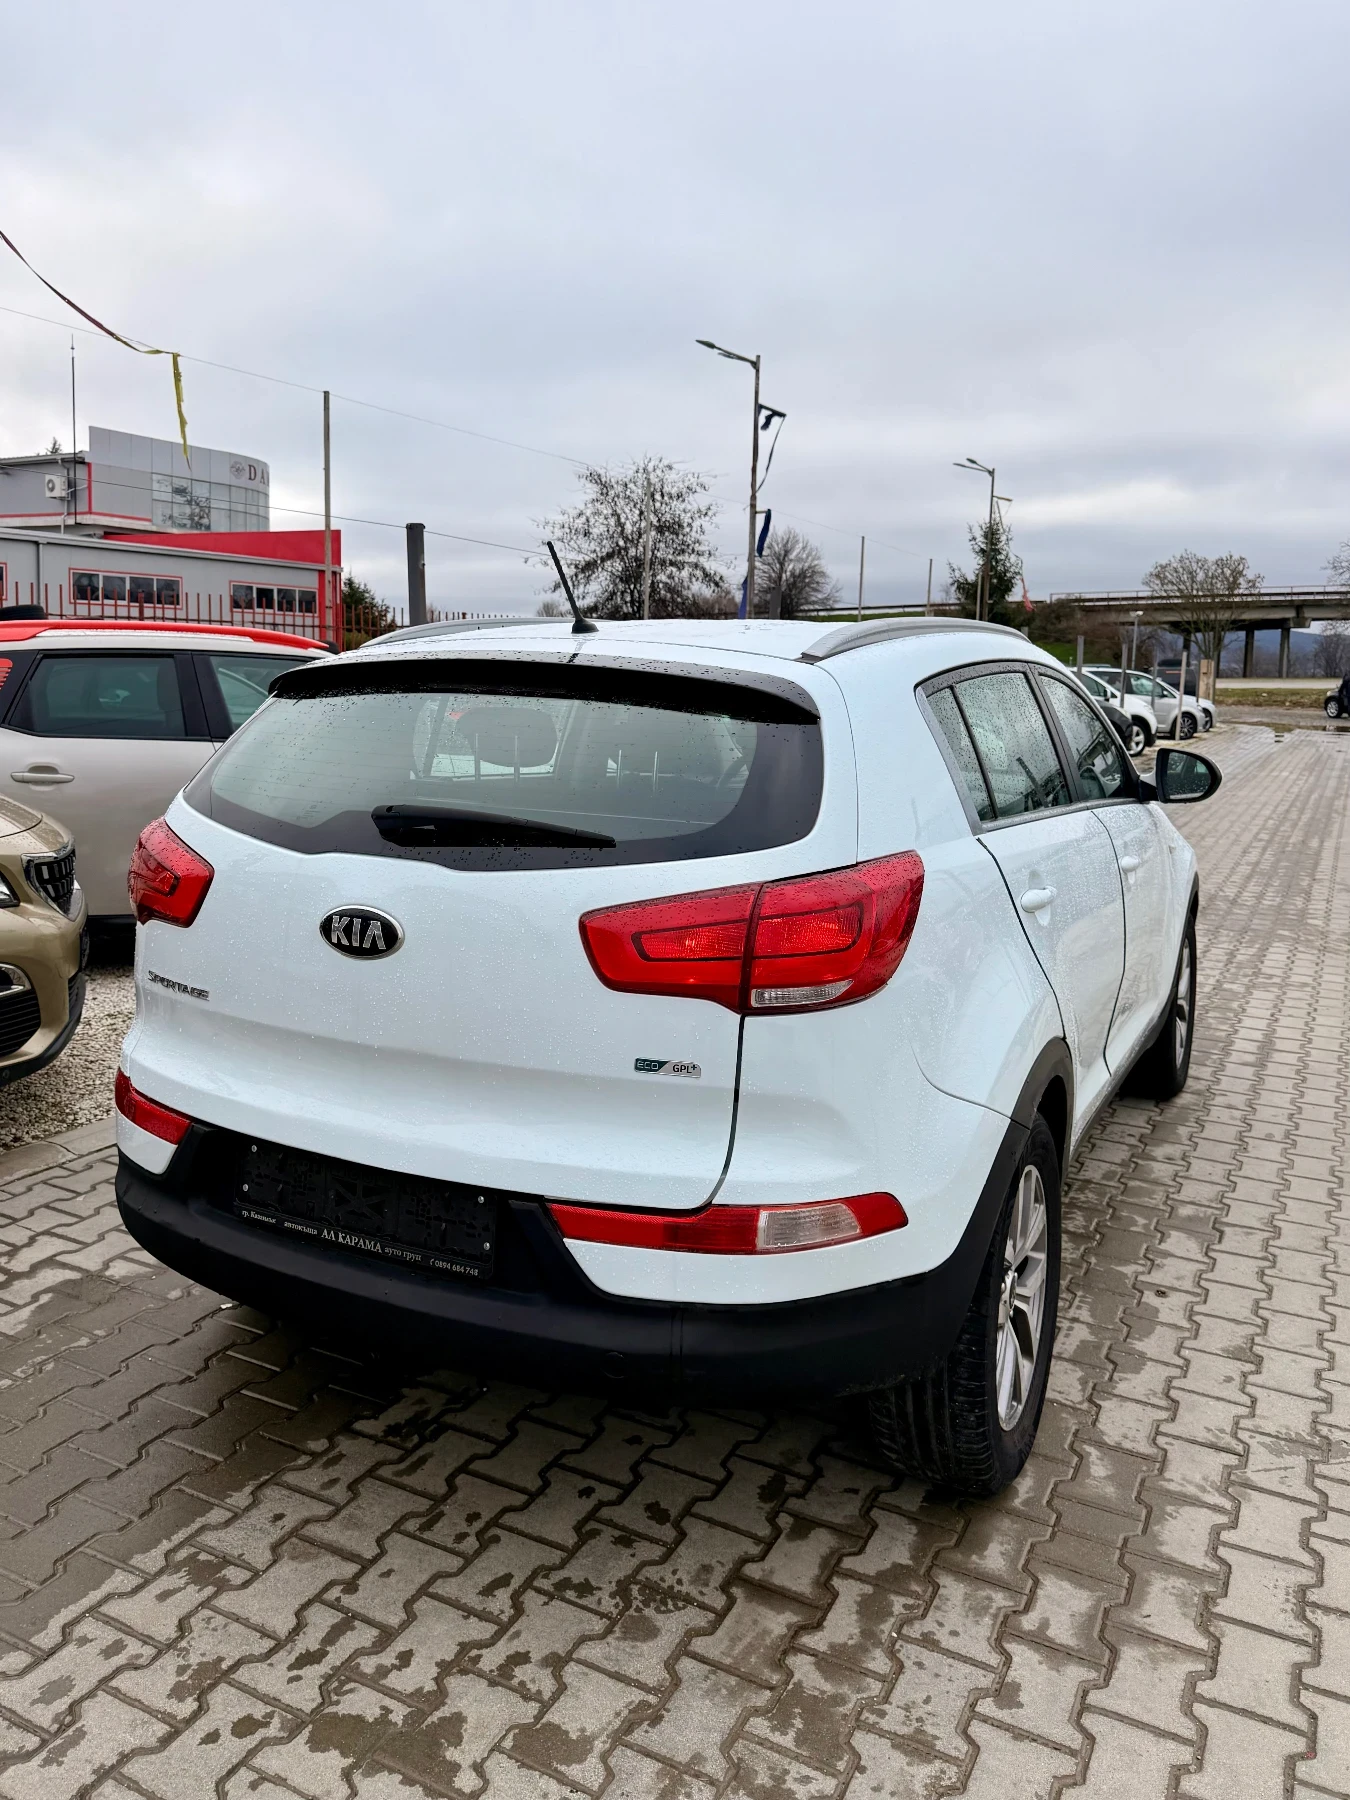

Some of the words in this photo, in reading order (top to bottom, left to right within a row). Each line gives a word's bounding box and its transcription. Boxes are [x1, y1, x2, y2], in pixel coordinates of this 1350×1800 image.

[248, 464, 269, 486] DA
[331, 915, 386, 950] KIA
[147, 969, 210, 1002] SPORTAGE
[637, 1061, 659, 1070] ECO
[338, 1232, 383, 1253] КАРАМА
